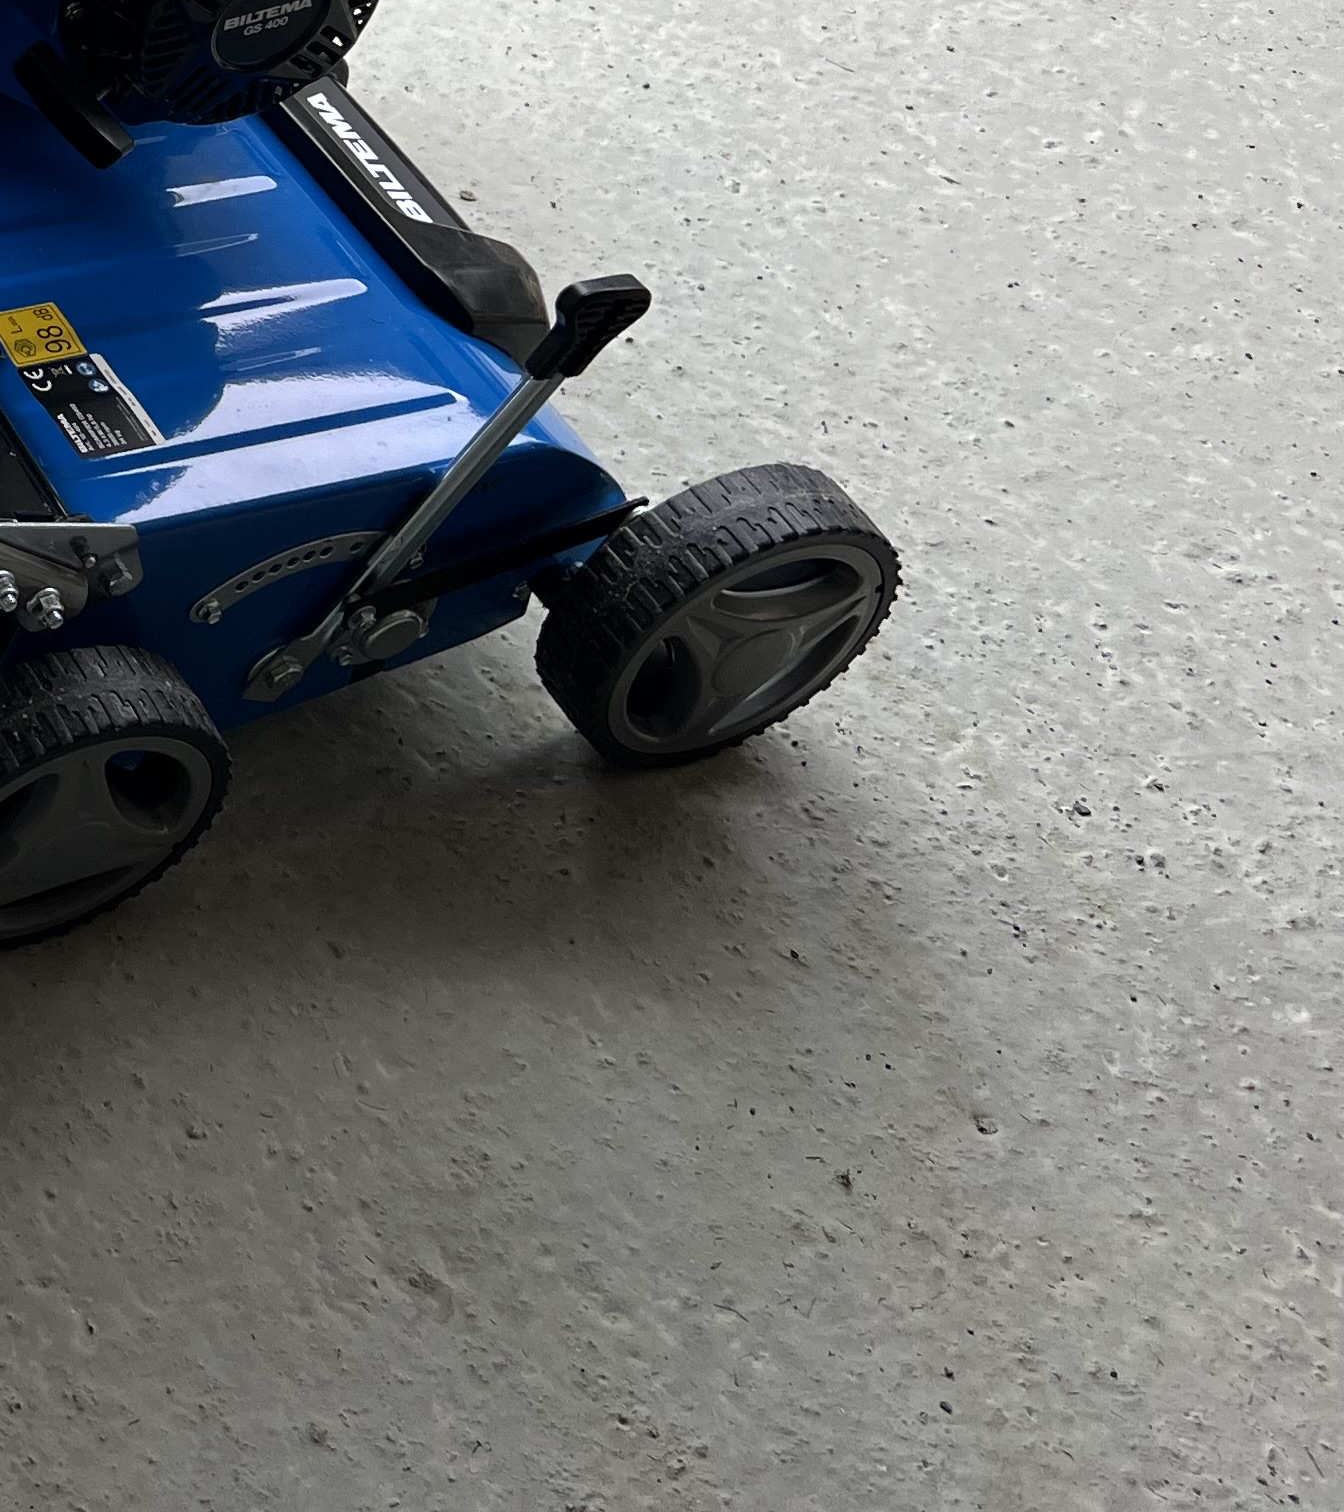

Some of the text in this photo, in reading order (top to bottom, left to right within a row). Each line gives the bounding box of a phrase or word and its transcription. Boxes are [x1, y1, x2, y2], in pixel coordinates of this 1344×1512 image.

[306, 92, 434, 224] BILTEMA
[32, 307, 72, 353] 98 dB
